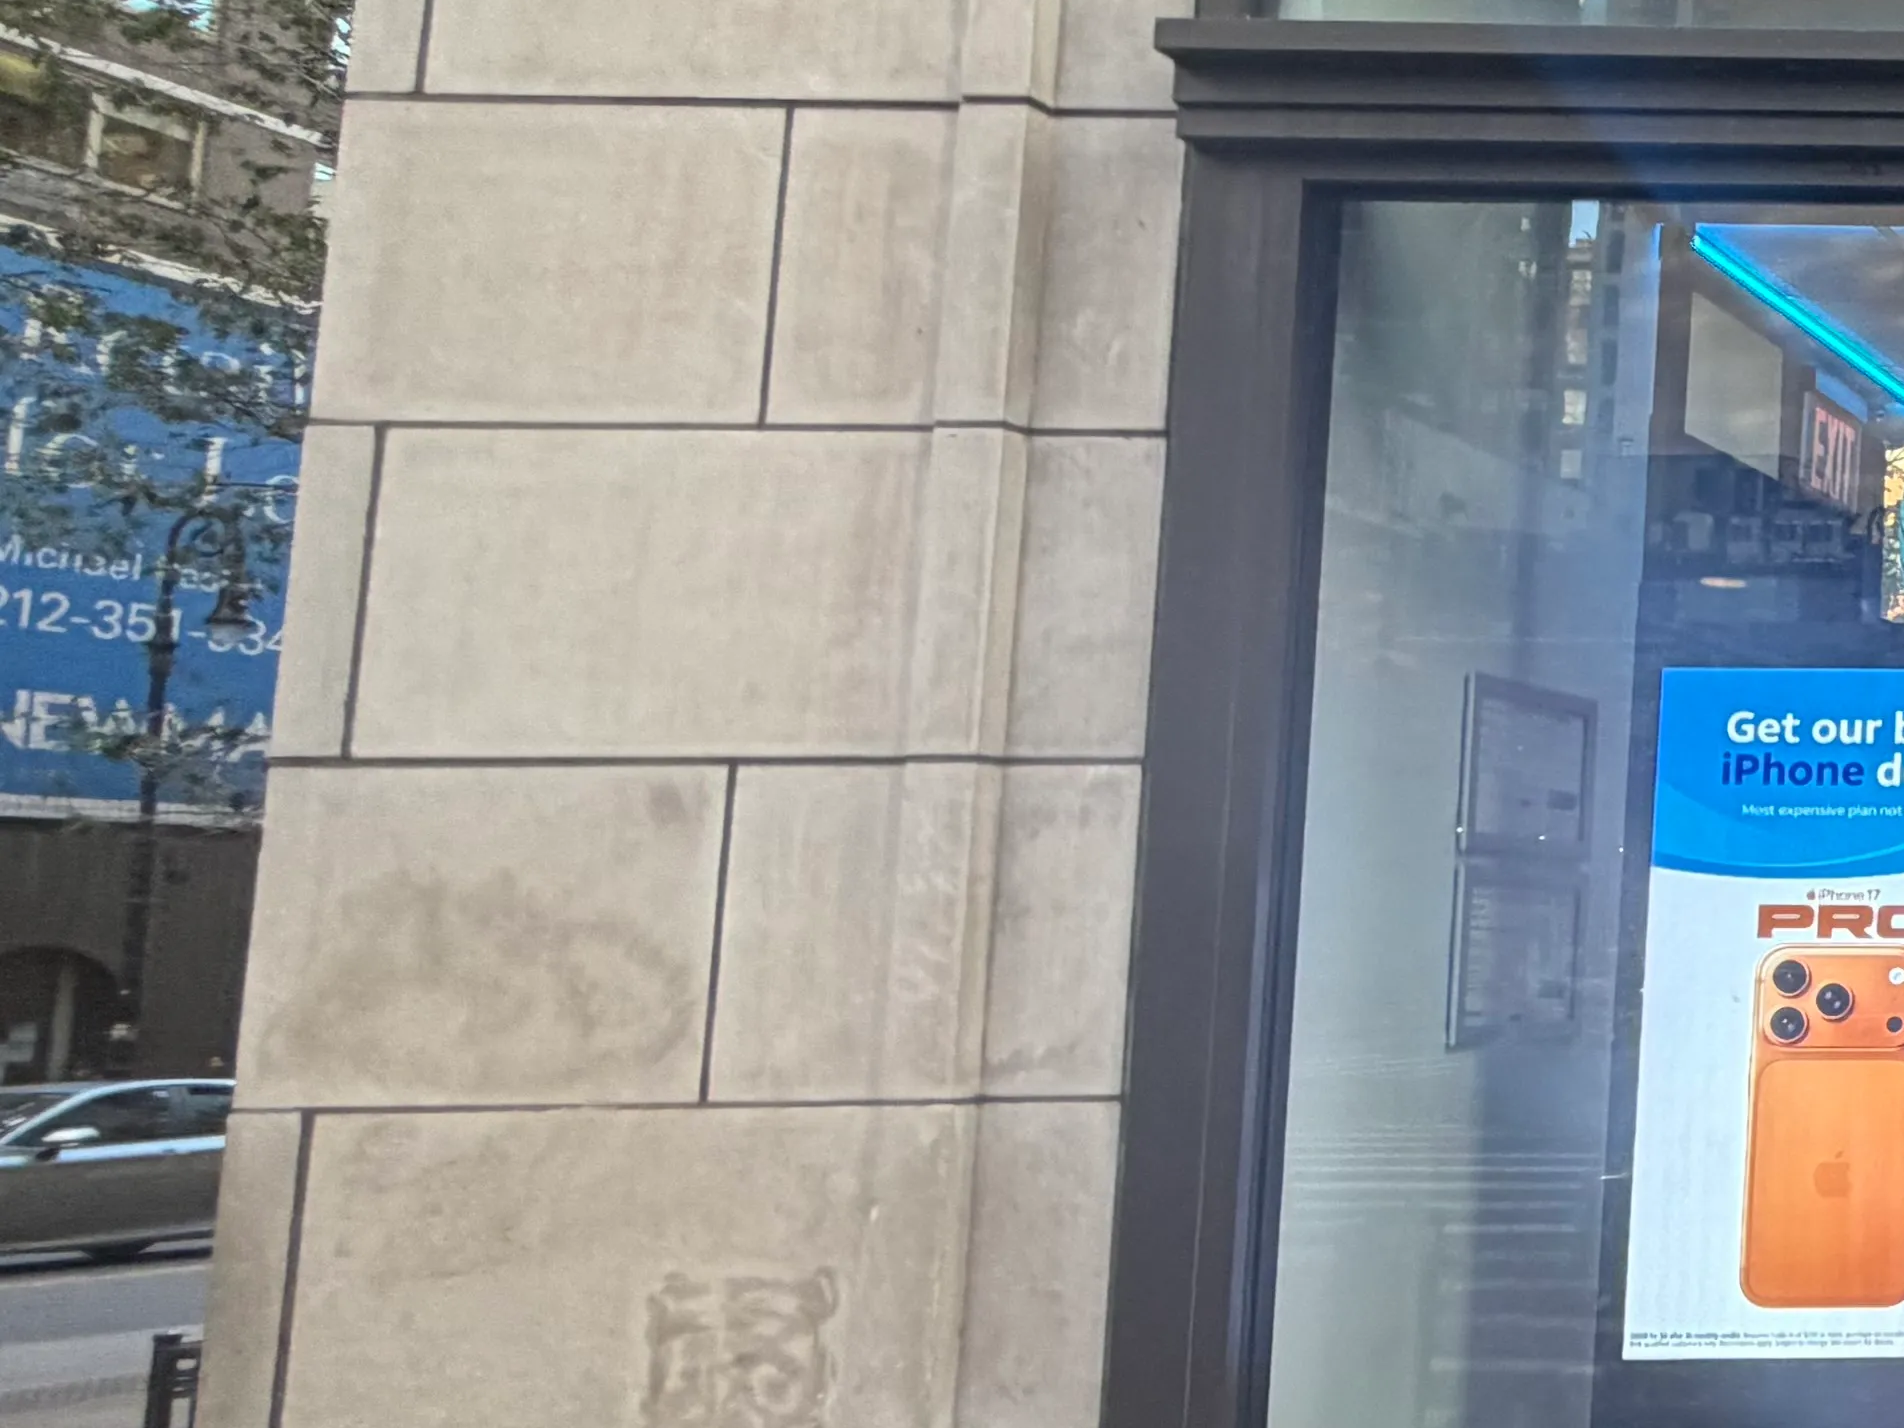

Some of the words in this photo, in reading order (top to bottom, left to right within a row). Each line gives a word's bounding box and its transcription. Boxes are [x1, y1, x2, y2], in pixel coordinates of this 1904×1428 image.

[1810, 405, 1856, 506] EXIT
[1726, 710, 1801, 745] Get
[1811, 718, 1883, 745] our
[1721, 751, 1865, 787] iPhone
[1742, 804, 1776, 817] Most
[1778, 805, 1845, 819] expensive
[1848, 805, 1877, 820] plan
[1879, 806, 1903, 818] not
[1818, 889, 1865, 902] iPhone
[1867, 889, 1881, 901] 17
